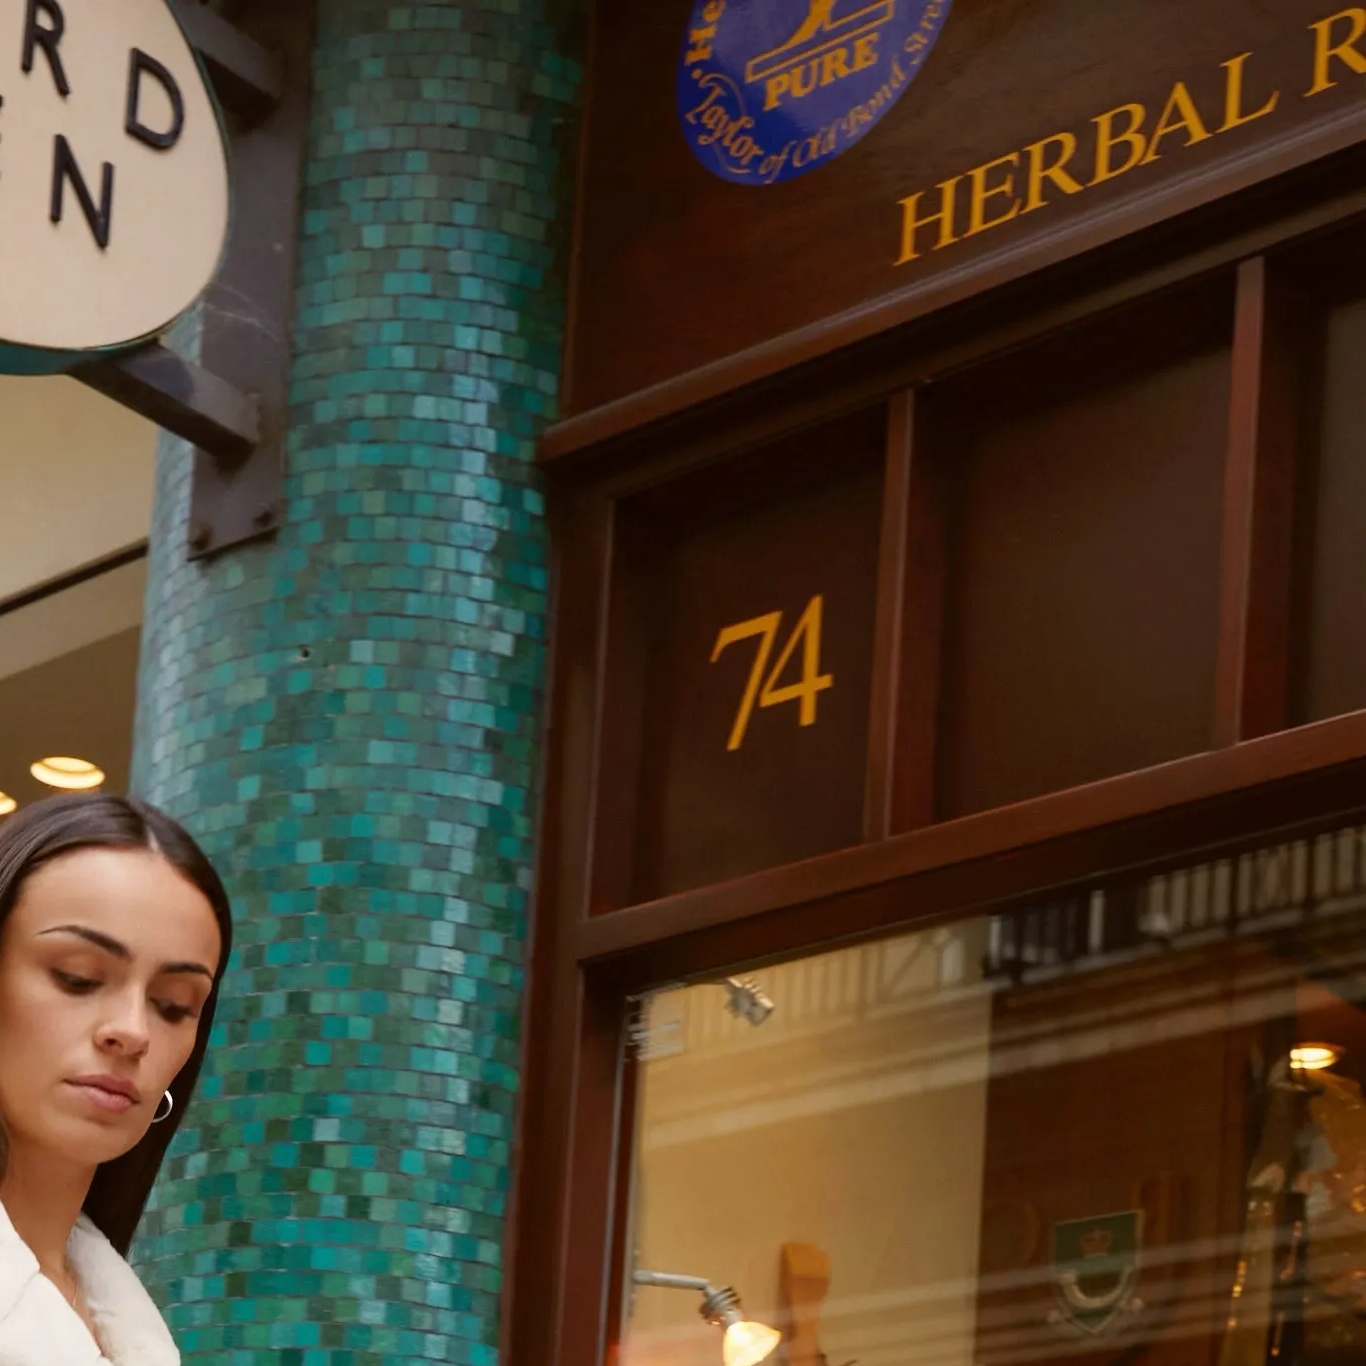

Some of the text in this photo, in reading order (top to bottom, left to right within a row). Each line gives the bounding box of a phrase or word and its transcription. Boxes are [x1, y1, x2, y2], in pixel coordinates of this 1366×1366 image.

[685, 73, 766, 173] Taylor
[757, 140, 796, 184] of
[762, 32, 880, 111] PURE
[892, 51, 1280, 266] HERBAL
[710, 593, 834, 751] 74
